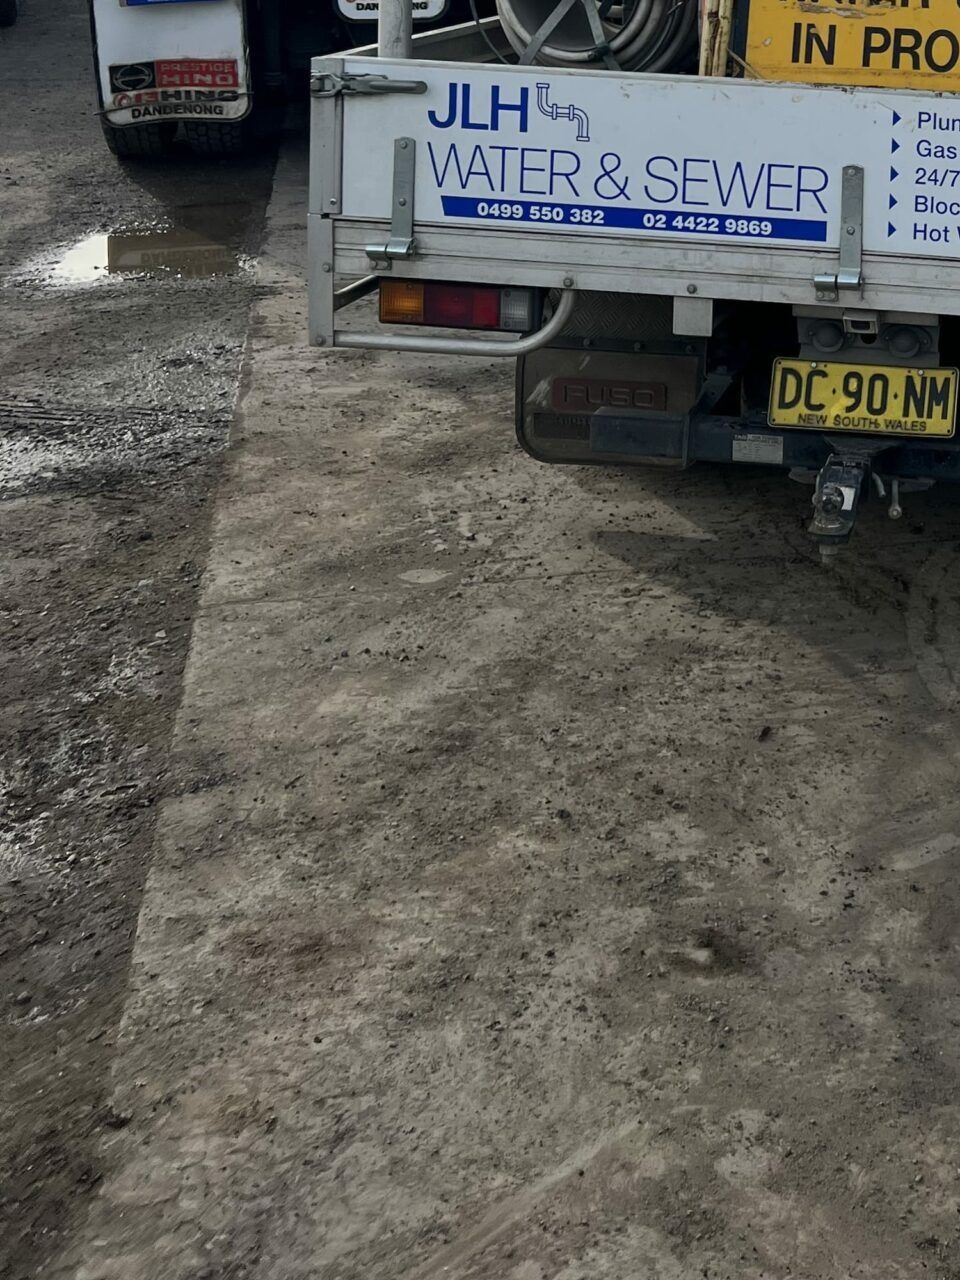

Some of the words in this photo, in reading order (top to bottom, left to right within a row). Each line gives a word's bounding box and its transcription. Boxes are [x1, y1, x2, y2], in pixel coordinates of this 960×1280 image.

[356, 2, 428, 11] DANNG
[791, 22, 836, 65] IN
[161, 63, 232, 73] PRESTIGE
[162, 74, 233, 84] HINO
[131, 104, 224, 119] DANDENONG
[428, 83, 529, 133] JLH
[916, 140, 957, 159] Gas
[427, 141, 581, 197] WATER
[594, 152, 631, 201] &
[644, 156, 828, 214] SEWER
[915, 167, 960, 188] 24/7
[477, 202, 523, 218] 0499
[529, 205, 563, 221] 550
[570, 208, 604, 224] 382
[643, 213, 667, 228] 02
[672, 215, 719, 232] 4422
[725, 218, 772, 236] 9869
[912, 223, 950, 243] Hot
[562, 384, 655, 407] FUSO
[798, 413, 828, 425] NEW
[833, 414, 878, 429] SOUTH
[885, 418, 927, 432] WALES
